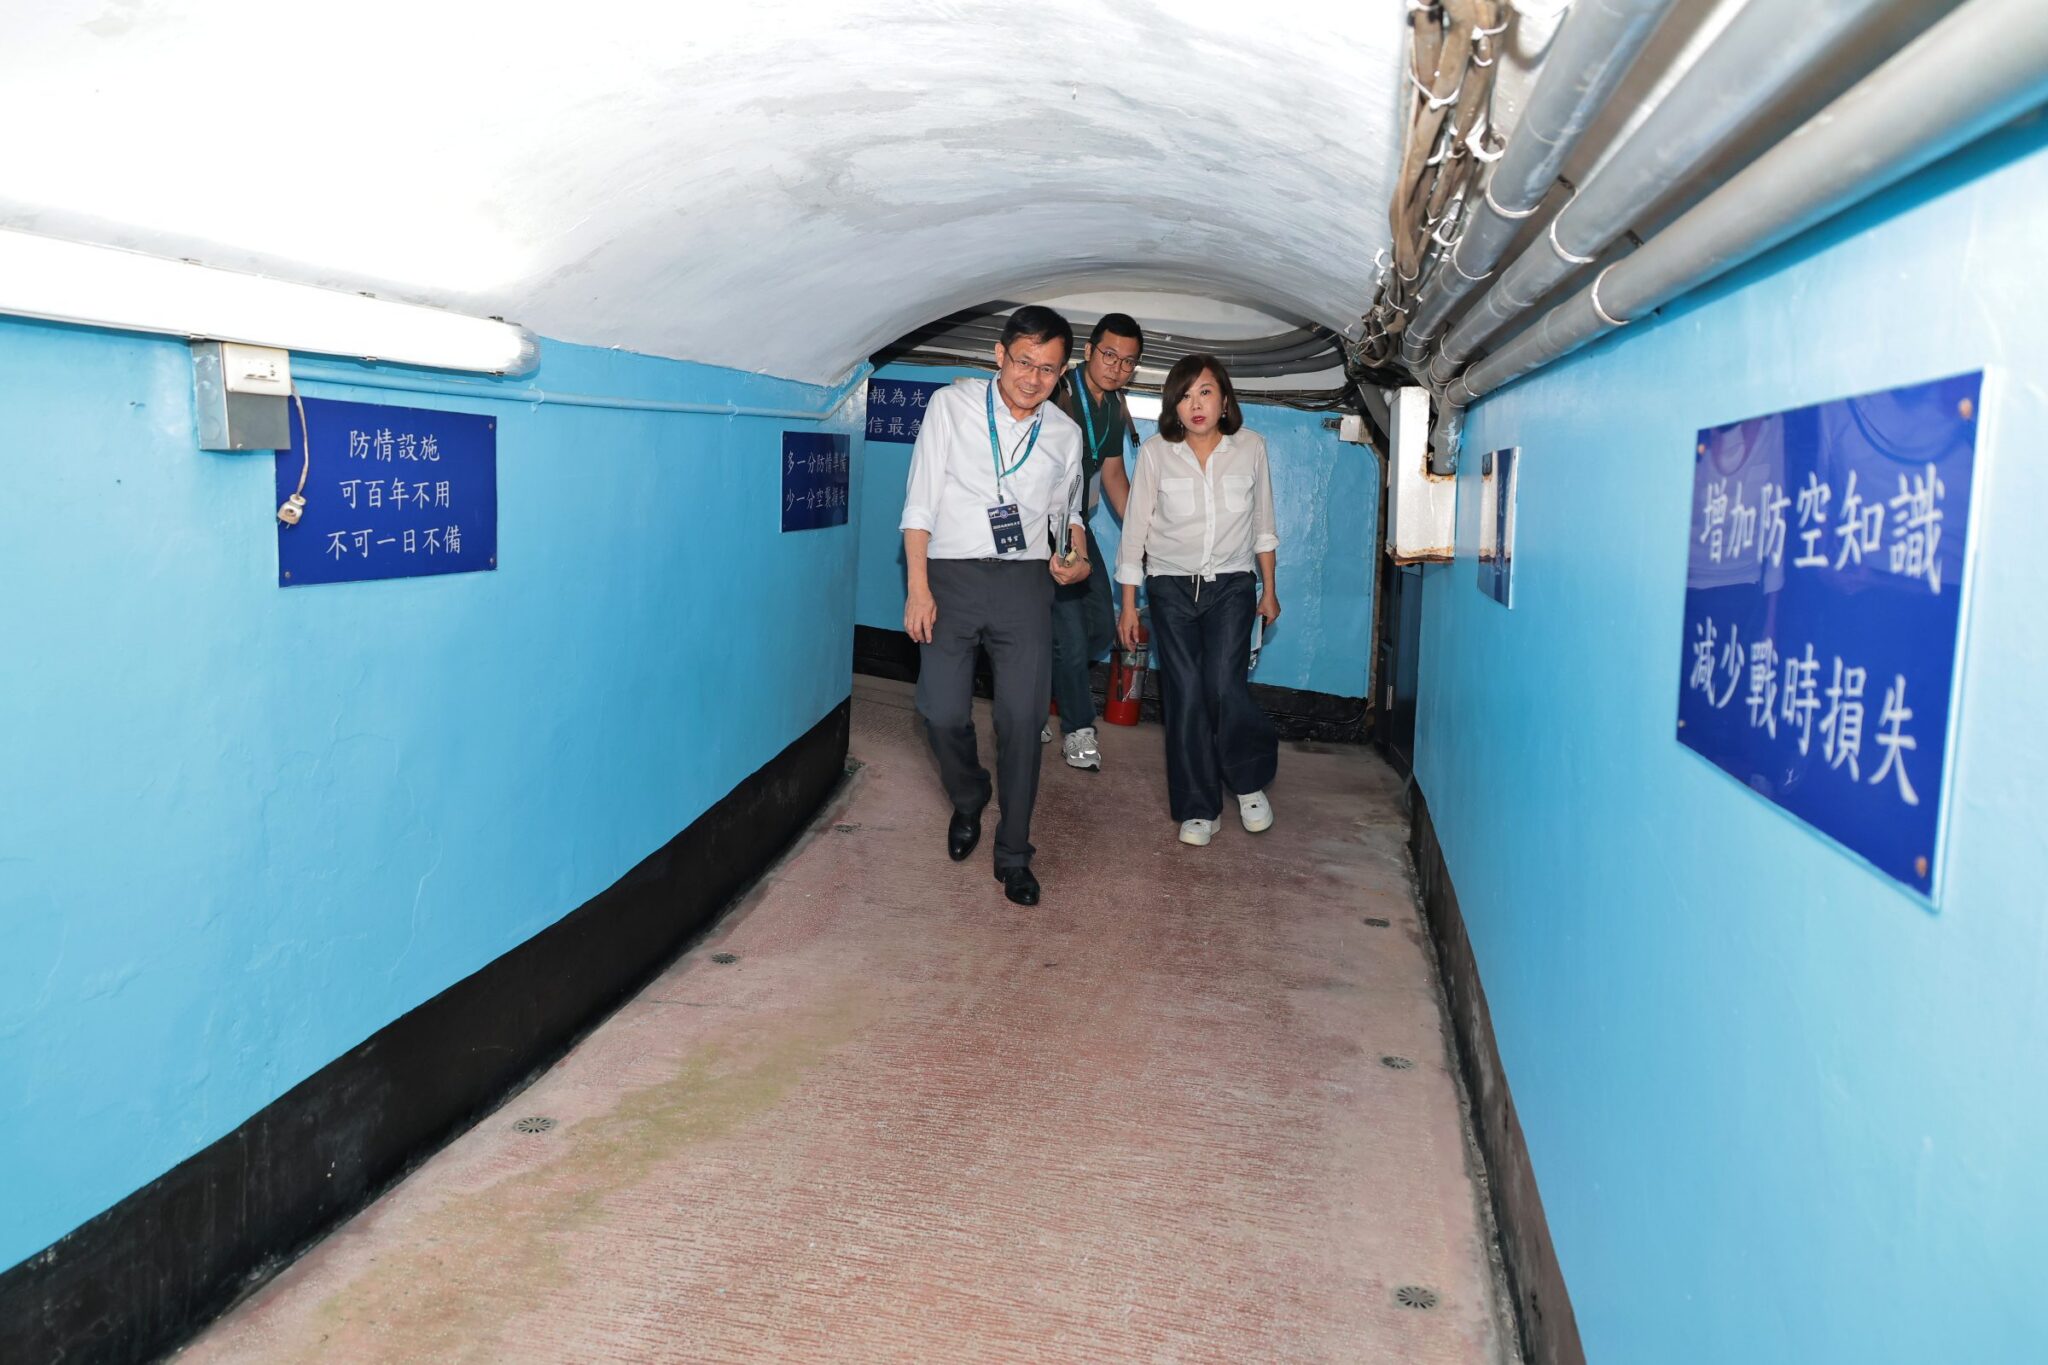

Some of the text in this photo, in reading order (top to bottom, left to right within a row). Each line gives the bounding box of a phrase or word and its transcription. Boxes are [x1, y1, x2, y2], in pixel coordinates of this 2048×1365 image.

[349, 428, 441, 463] 防情設施
[339, 477, 451, 511] 可百年不用
[326, 525, 462, 561] 不可一日不備
[1699, 462, 1945, 595] 增加防空知識
[1689, 616, 1920, 806] 減少戰時損失
